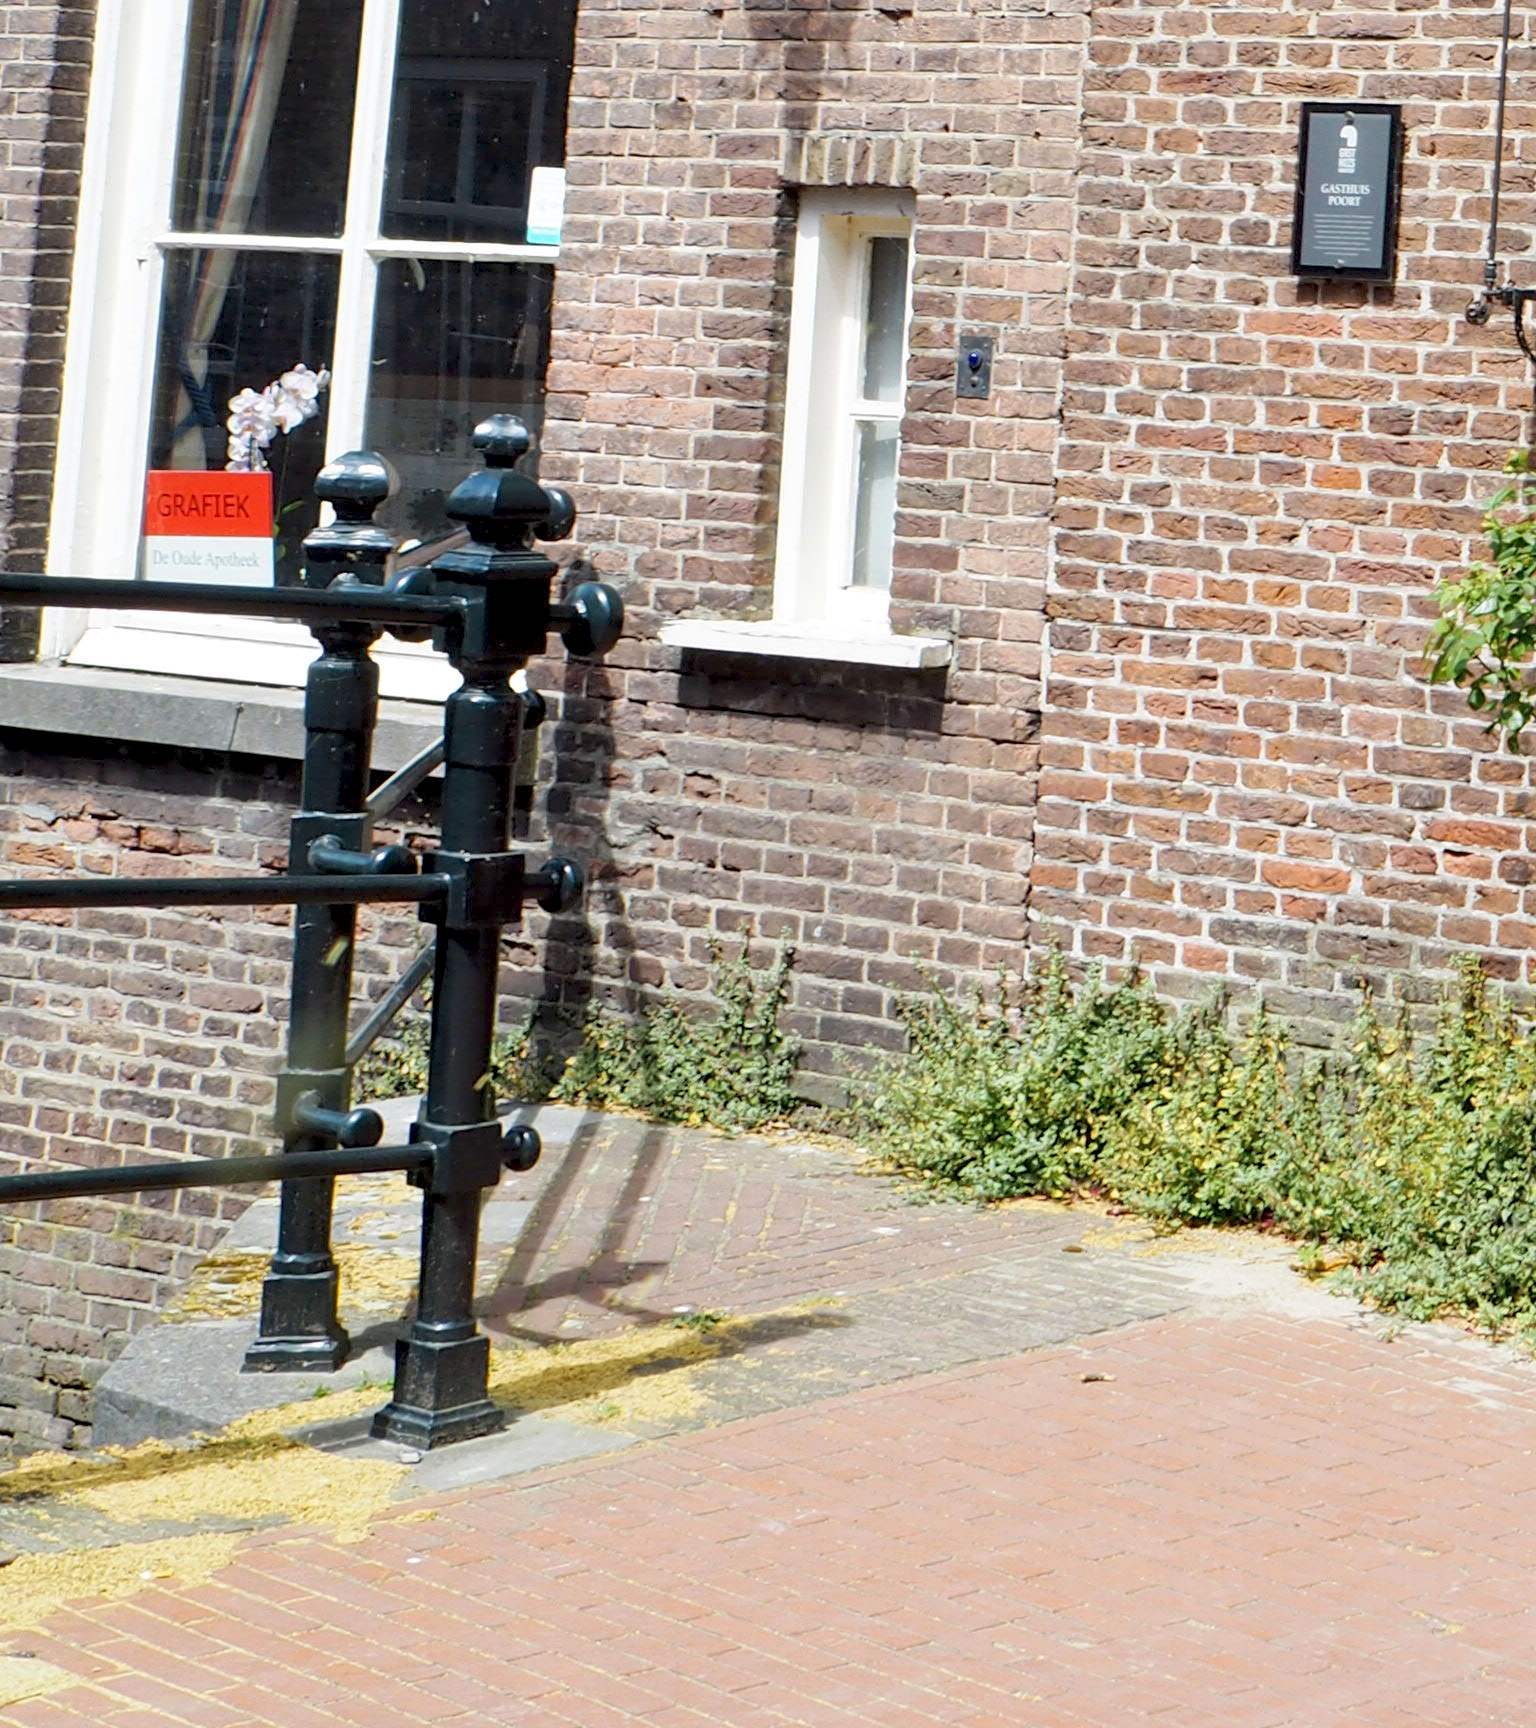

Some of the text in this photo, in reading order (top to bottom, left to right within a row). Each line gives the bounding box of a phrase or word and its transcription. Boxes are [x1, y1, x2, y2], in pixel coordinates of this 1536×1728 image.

[1320, 183, 1370, 195] GASTHUIS
[1328, 195, 1361, 207] POORT
[157, 494, 249, 518] GRAFIEK
[153, 549, 168, 565] De
